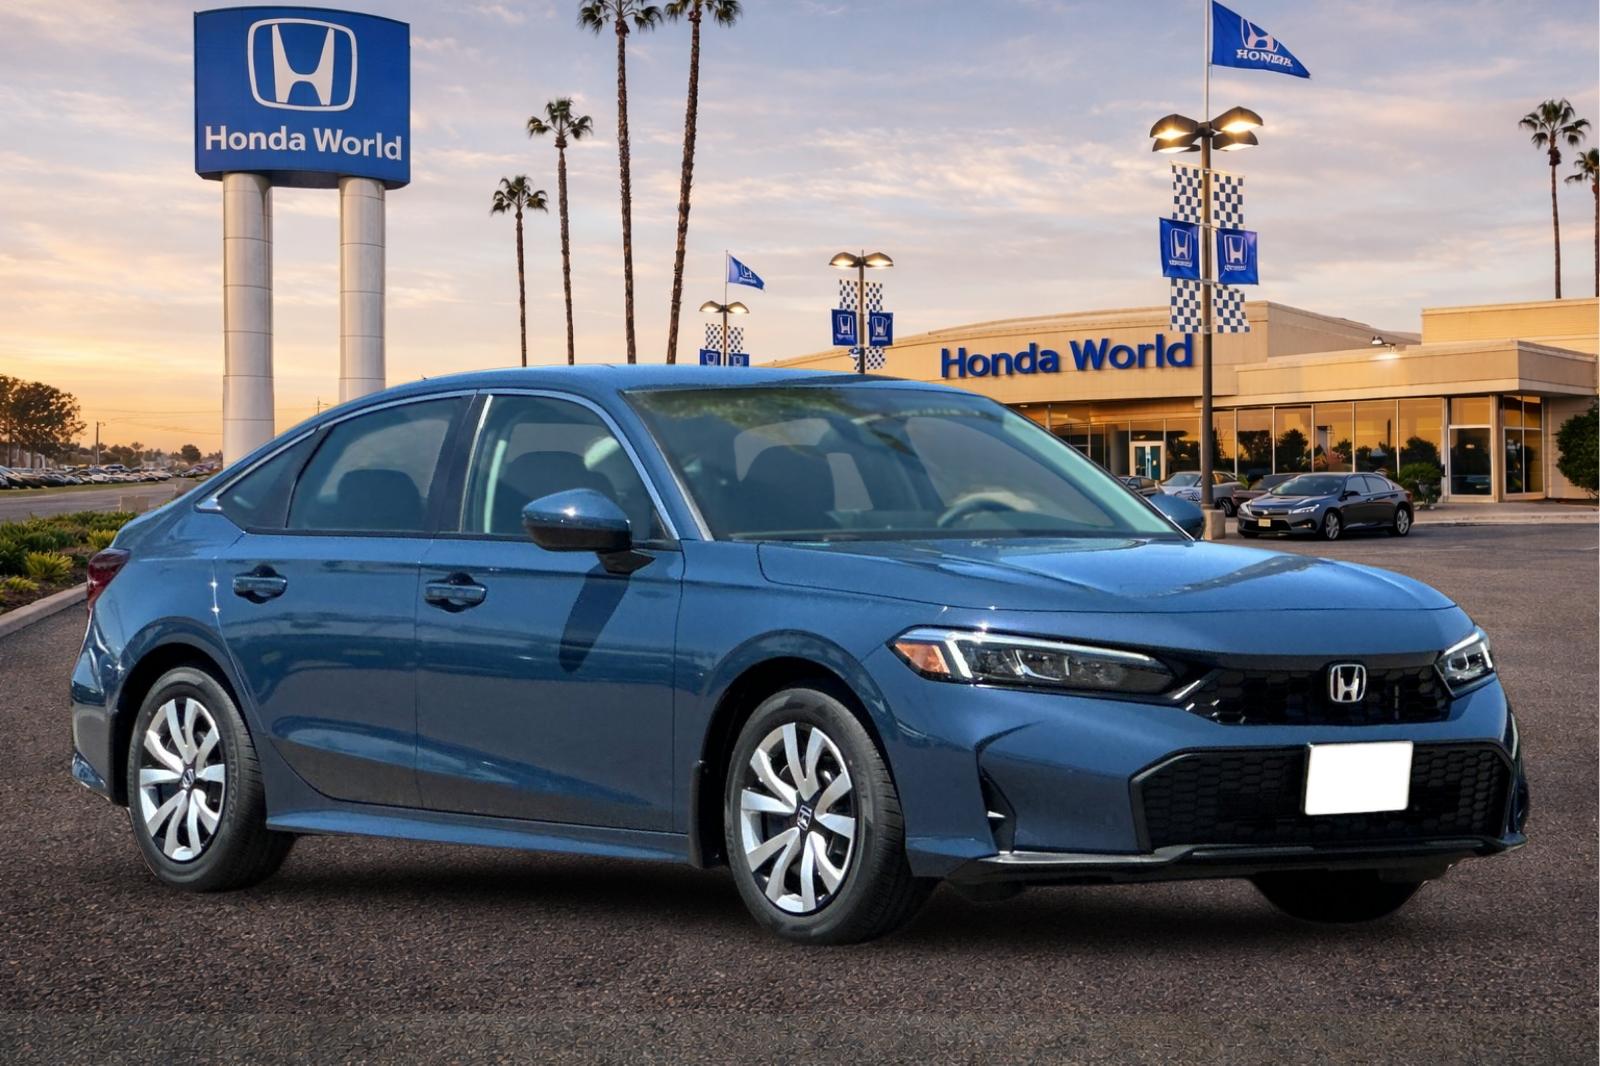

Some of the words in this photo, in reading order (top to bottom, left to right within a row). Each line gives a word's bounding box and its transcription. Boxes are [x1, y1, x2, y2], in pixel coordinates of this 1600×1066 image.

[205, 125, 306, 151] Honda
[313, 127, 402, 161] World
[941, 342, 1061, 378] Honda
[1069, 333, 1194, 371] World
